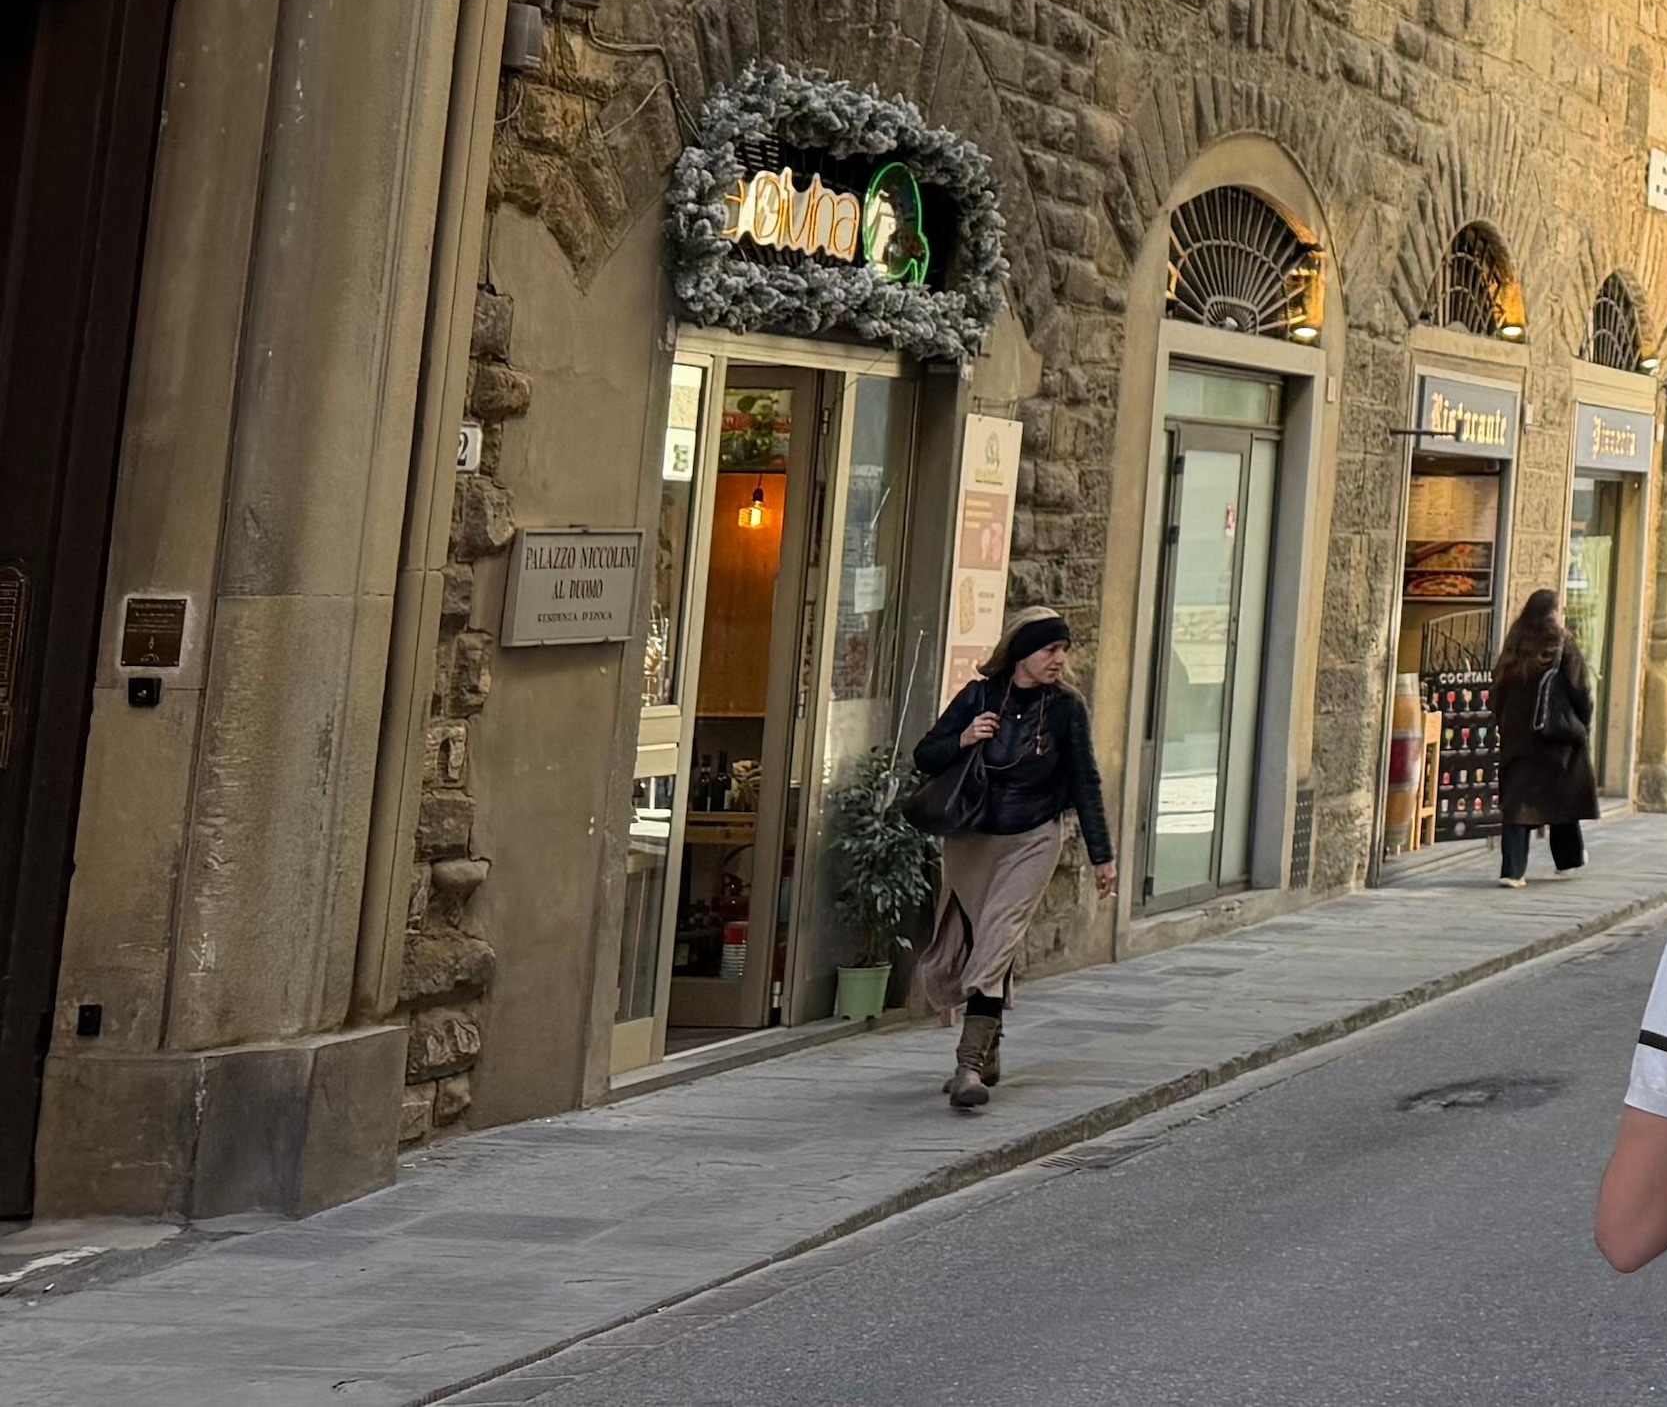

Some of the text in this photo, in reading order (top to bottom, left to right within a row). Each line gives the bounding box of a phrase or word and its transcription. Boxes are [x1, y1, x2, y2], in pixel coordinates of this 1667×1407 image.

[525, 546, 637, 570] PALAZZO NICCOLINI
[552, 578, 603, 600] AL DUOMO
